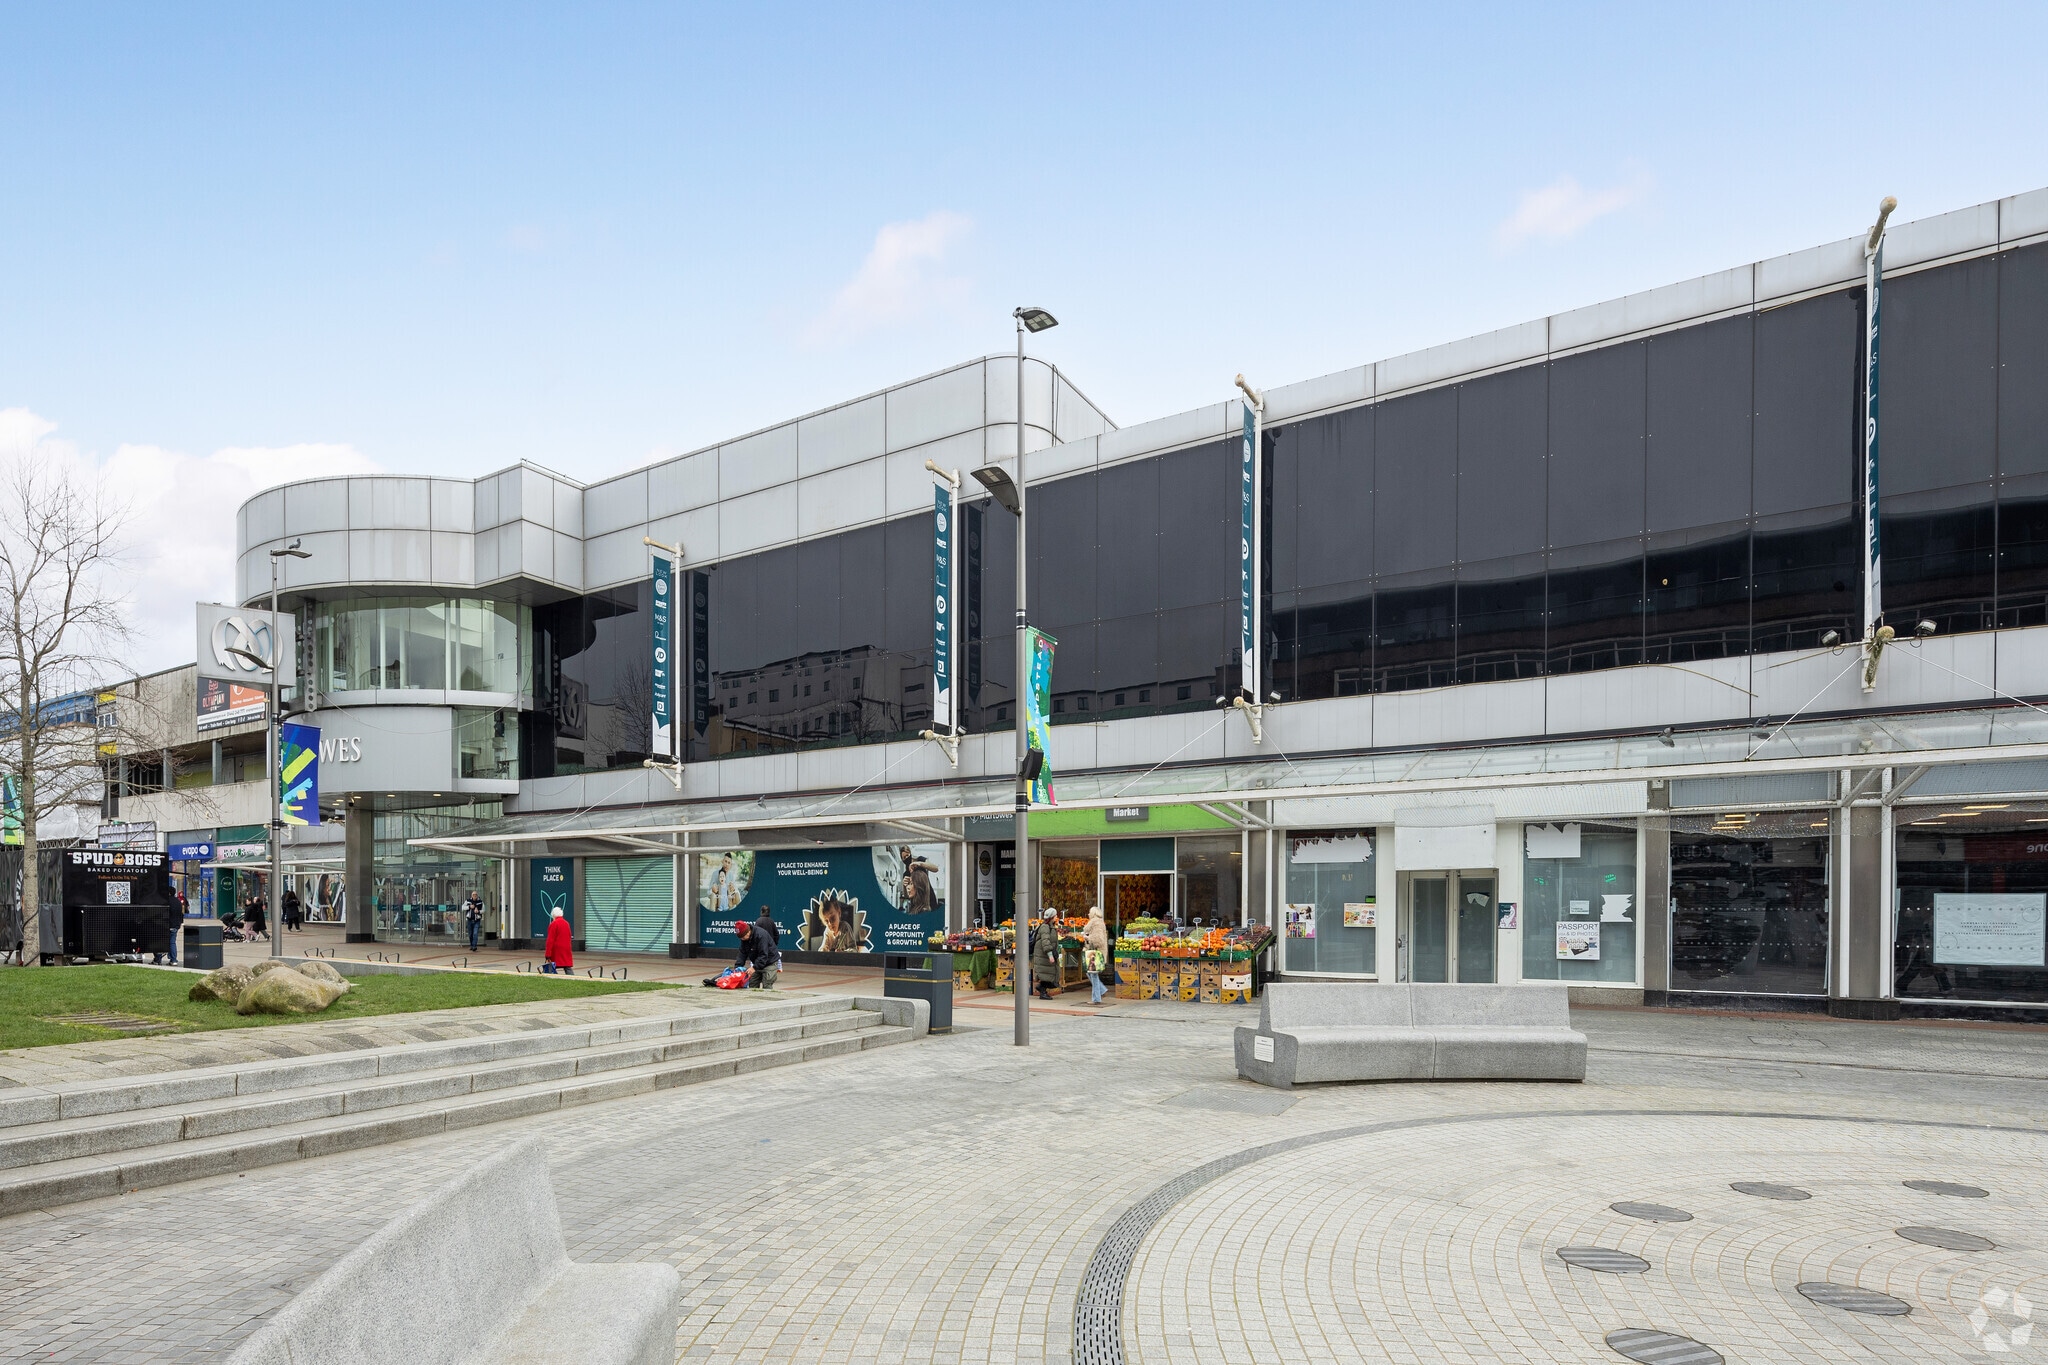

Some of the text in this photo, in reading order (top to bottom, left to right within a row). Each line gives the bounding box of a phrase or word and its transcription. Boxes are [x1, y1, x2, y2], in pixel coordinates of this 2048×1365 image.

[654, 613, 667, 623] M&S
[1113, 807, 1139, 817] Market
[182, 846, 198, 857] evapo
[72, 852, 161, 866] SPUD BOSS
[1558, 923, 1599, 931] PASSPORT
